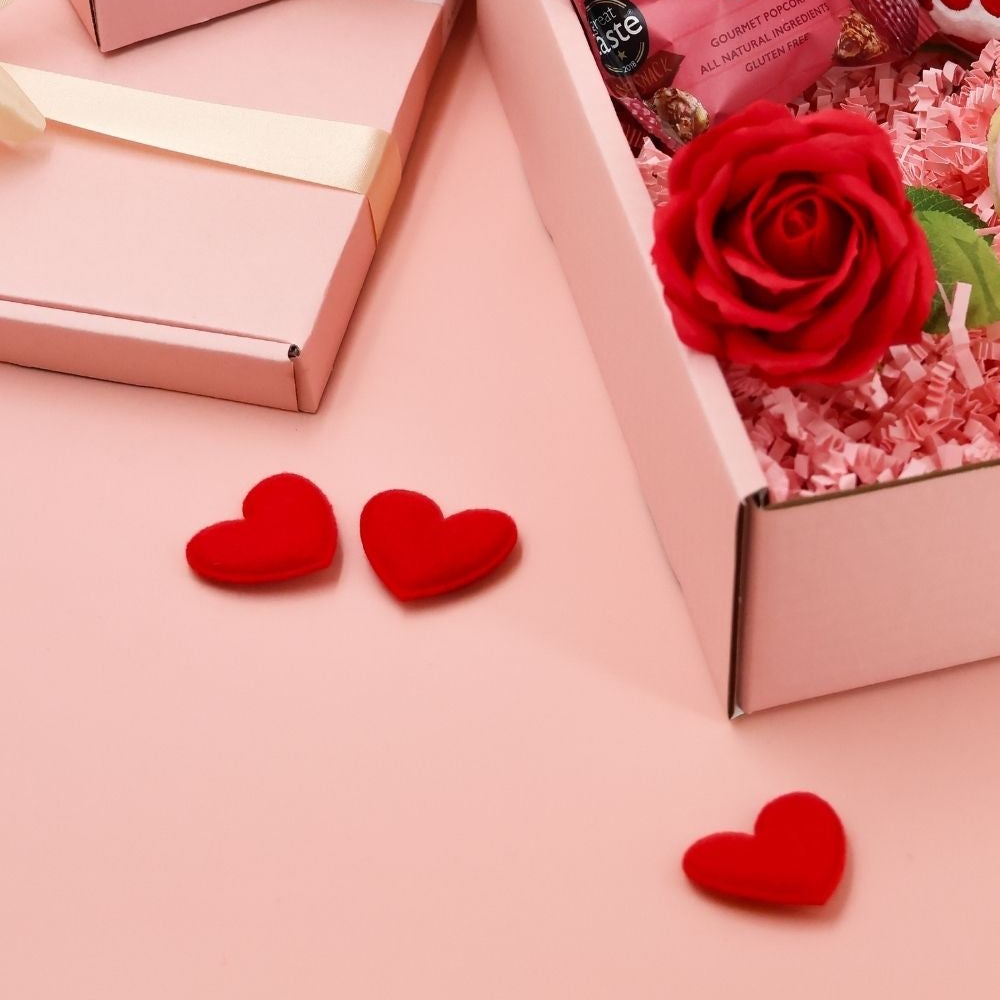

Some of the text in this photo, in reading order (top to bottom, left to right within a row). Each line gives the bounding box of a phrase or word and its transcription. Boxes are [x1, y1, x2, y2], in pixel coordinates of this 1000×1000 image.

[594, 15, 643, 55] aste
[700, 2, 831, 75] ALL NATURAL INGREDIENTS
[710, 16, 762, 48] GOURMET
[622, 60, 637, 73] 2018
[745, 32, 810, 73] GLUTEN FREE
